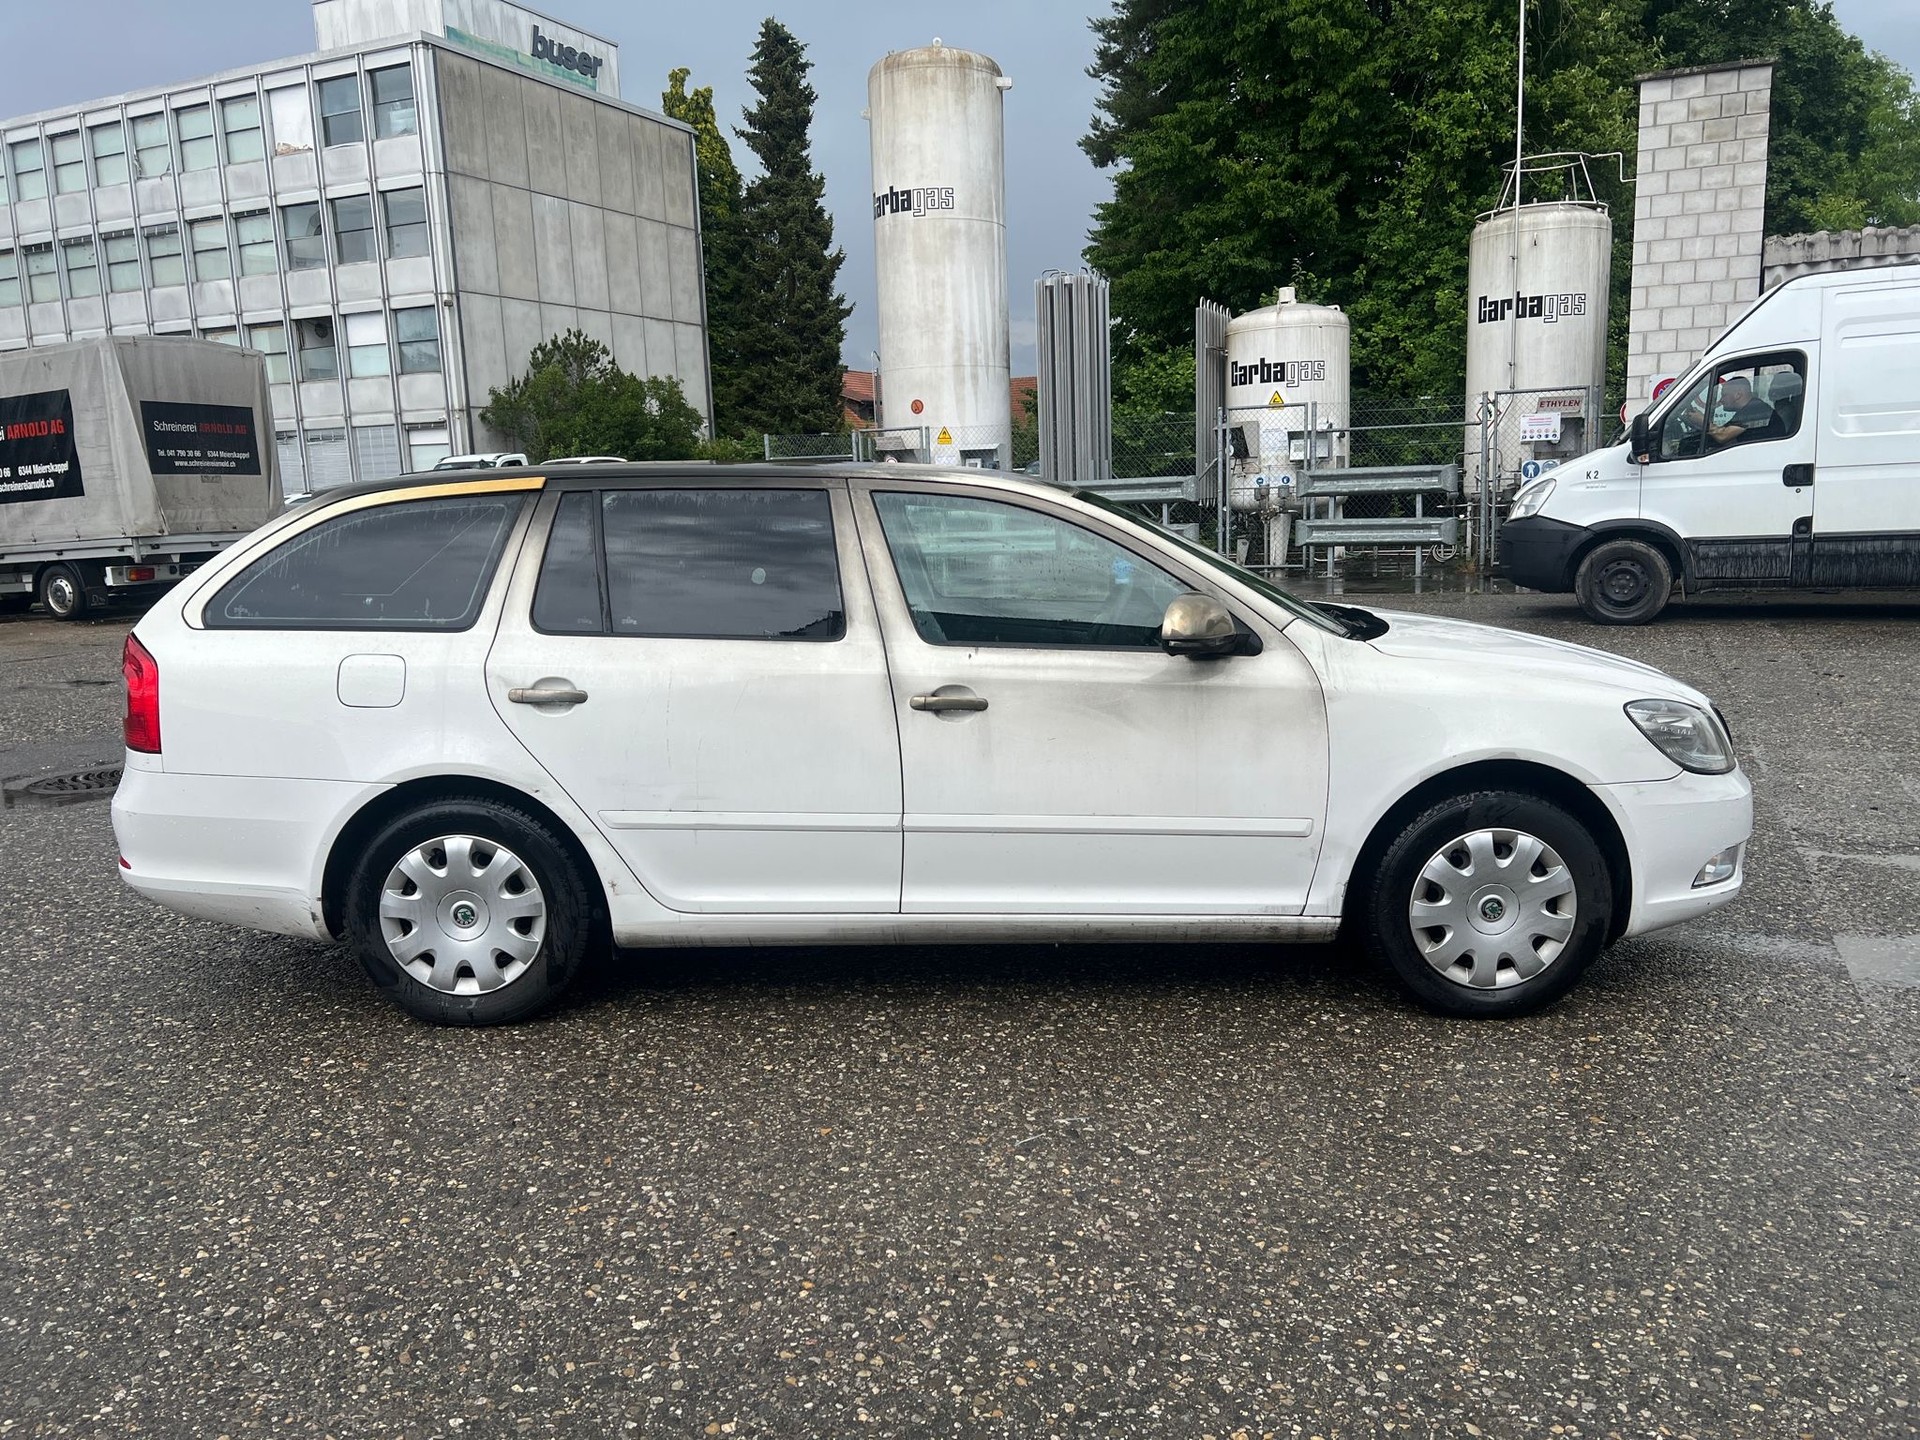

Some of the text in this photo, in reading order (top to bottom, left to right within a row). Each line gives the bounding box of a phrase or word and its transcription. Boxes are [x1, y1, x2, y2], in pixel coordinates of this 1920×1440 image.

[531, 24, 603, 79] buser
[1478, 291, 1587, 324] Carbagas
[1231, 357, 1326, 388] Carbagas
[1540, 400, 1581, 408] ETHYLEN
[7, 420, 49, 440] ARNOLD
[50, 419, 64, 434] AG
[153, 420, 247, 435] Schreinerei ARNOLD AG
[219, 450, 250, 460] Meierskappel
[3, 467, 11, 478] 66
[18, 465, 32, 476] 6344
[33, 461, 69, 474] Meierskappel
[1586, 470, 1599, 480] K 2
